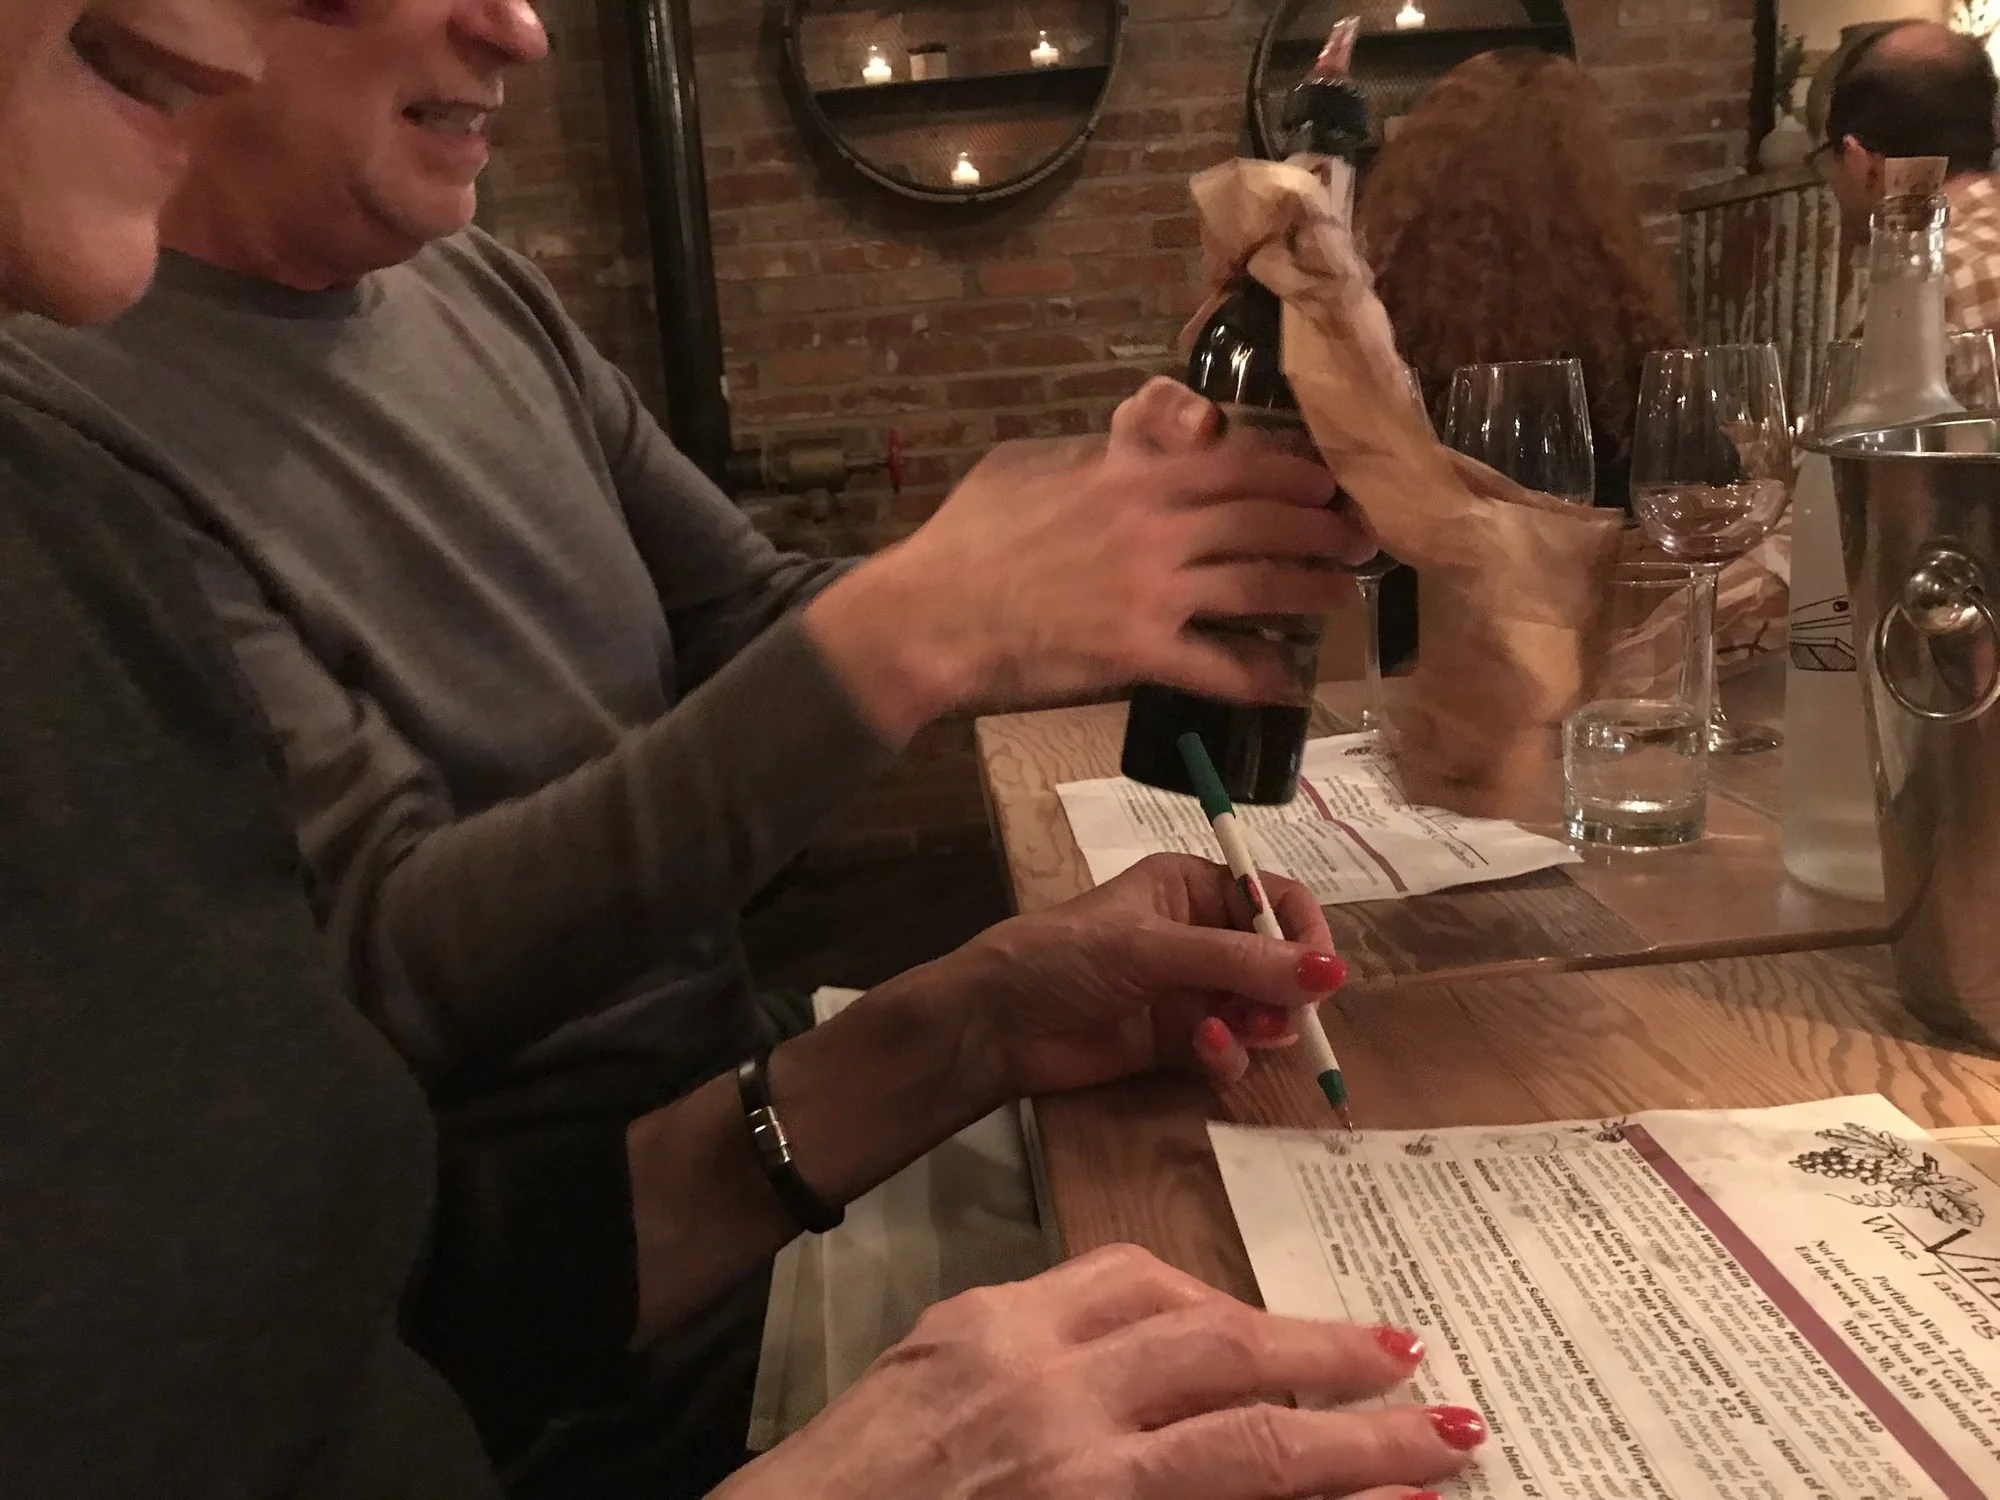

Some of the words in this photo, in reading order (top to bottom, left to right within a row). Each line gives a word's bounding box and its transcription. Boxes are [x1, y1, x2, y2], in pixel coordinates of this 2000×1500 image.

[1473, 1205, 1488, 1213] of
[1480, 1215, 1513, 1257] Substance
[1636, 1224, 1653, 1237] the
[1390, 1268, 1415, 1299] grapes
[1412, 1308, 1432, 1326] $35
[1508, 1259, 1531, 1284] Super
[1622, 1148, 1644, 1164] 2015
[1638, 1165, 1662, 1186] Seven
[1660, 1188, 1679, 1204] Hills
[1677, 1206, 1705, 1231] Merlot
[1700, 1234, 1727, 1259] Walla
[1724, 1260, 1751, 1288] Walla
[1756, 1299, 1786, 1328] 100%
[1785, 1331, 1821, 1364] Merlot
[1813, 1367, 1851, 1400] grape
[1854, 1411, 1884, 1433] $40
[1675, 1275, 1690, 1284] to
[1682, 1286, 1701, 1298] go
[1862, 1216, 1918, 1260] Wine
[1918, 1263, 2000, 1339] Tasting
[1526, 1287, 1565, 1337] Substance
[1592, 1230, 1618, 1257] Merlot
[1612, 1259, 1625, 1267] &
[1619, 1269, 1637, 1285] 1%
[1634, 1287, 1658, 1310] Petit
[1653, 1312, 1686, 1346] Verdot
[1677, 1349, 1715, 1386] grapes
[1716, 1397, 1743, 1419] $32
[1653, 1200, 1673, 1217] from
[1668, 1218, 1685, 1231] the
[1680, 1232, 1716, 1263] original
[1706, 1264, 1737, 1292] Merlot
[1730, 1294, 1761, 1321] blocks
[1756, 1323, 1774, 1333] at
[1767, 1335, 1789, 1353] this
[1824, 1404, 1870, 1443] planted
[1864, 1446, 1881, 1457] in
[1695, 1299, 1715, 1314] the
[1709, 1315, 1748, 1356] distance.
[1816, 1240, 1835, 1255] Not
[1829, 1258, 1856, 1276] Just
[1851, 1277, 1886, 1305] Good
[1878, 1306, 1914, 1339] Friday
[1913, 1342, 1946, 1366] BUT
[1941, 1369, 1994, 1413] GREAT
[1873, 1276, 1924, 1317] Portland
[1919, 1318, 1949, 1346] Wine
[1948, 1348, 1993, 1390] Tasting
[1560, 1340, 1590, 1374] Merlot
[1592, 1208, 1617, 1230] Hand
[1610, 1232, 1639, 1262] Cellars
[1692, 1337, 1737, 1388] Columbia
[1734, 1390, 1768, 1426] Valley
[1773, 1439, 1810, 1474] blend
[1803, 1477, 1825, 1491] of
[1644, 1215, 1682, 1251] generous
[1704, 1284, 1724, 1300] The
[1720, 1302, 1750, 1332] flavors
[1745, 1334, 1771, 1354] coat
[1764, 1357, 1786, 1374] the
[1777, 1376, 1814, 1408] palate
[1810, 1410, 1839, 1435] from
[1833, 1437, 1862, 1458] end
[1853, 1460, 1872, 1473] to
[1745, 1360, 1762, 1368] It
[1794, 1246, 1822, 1264] End
[1814, 1266, 1834, 1281] the
[1831, 1282, 1860, 1308] week
[1853, 1309, 1874, 1322] @
[1868, 1323, 1913, 1364] LeChon
[1909, 1366, 1928, 1377] &
[1927, 1379, 1993, 1447] Washington
[1843, 1319, 1879, 1354] March
[1873, 1356, 1895, 1373] 30,
[1890, 1374, 1925, 1400] 2018
[1429, 1303, 1461, 1350] Garnacha
[1455, 1353, 1476, 1375] Red
[1469, 1379, 1503, 1434] Mountain
[1502, 1446, 1531, 1481] blend
[1522, 1483, 1541, 1497] of
[1537, 1335, 1554, 1351] the
[1565, 1382, 1592, 1413] Super
[1586, 1416, 1630, 1474] Substance
[1585, 1378, 1631, 1441] Northridge
[1632, 1311, 1671, 1351] Cabernet
[1688, 1389, 1709, 1406] 8%
[1705, 1410, 1739, 1443] Merlot
[1732, 1446, 1759, 1467] and
[1750, 1469, 1765, 1477] a
[1755, 1371, 1779, 1388] will
[1770, 1390, 1789, 1403] be
[1492, 1356, 1513, 1378] well
[1503, 1379, 1524, 1403] over
[1516, 1406, 1535, 1424] the
[1529, 1427, 1565, 1477] following
[1638, 1375, 1654, 1386] to
[1648, 1388, 1675, 1415] drink
[1669, 1419, 1698, 1450] nicely
[1694, 1453, 1722, 1481] right
[1657, 1370, 1681, 1397] notes
[1676, 1399, 1694, 1410] of
[1687, 1414, 1725, 1456] tobacco
[1783, 1405, 1812, 1427] best
[1804, 1430, 1835, 1455] after
[1471, 1473, 1490, 1492] the
[1571, 1426, 1596, 1454] color
[1589, 1457, 1605, 1470] as
[1601, 1474, 1626, 1497] well
